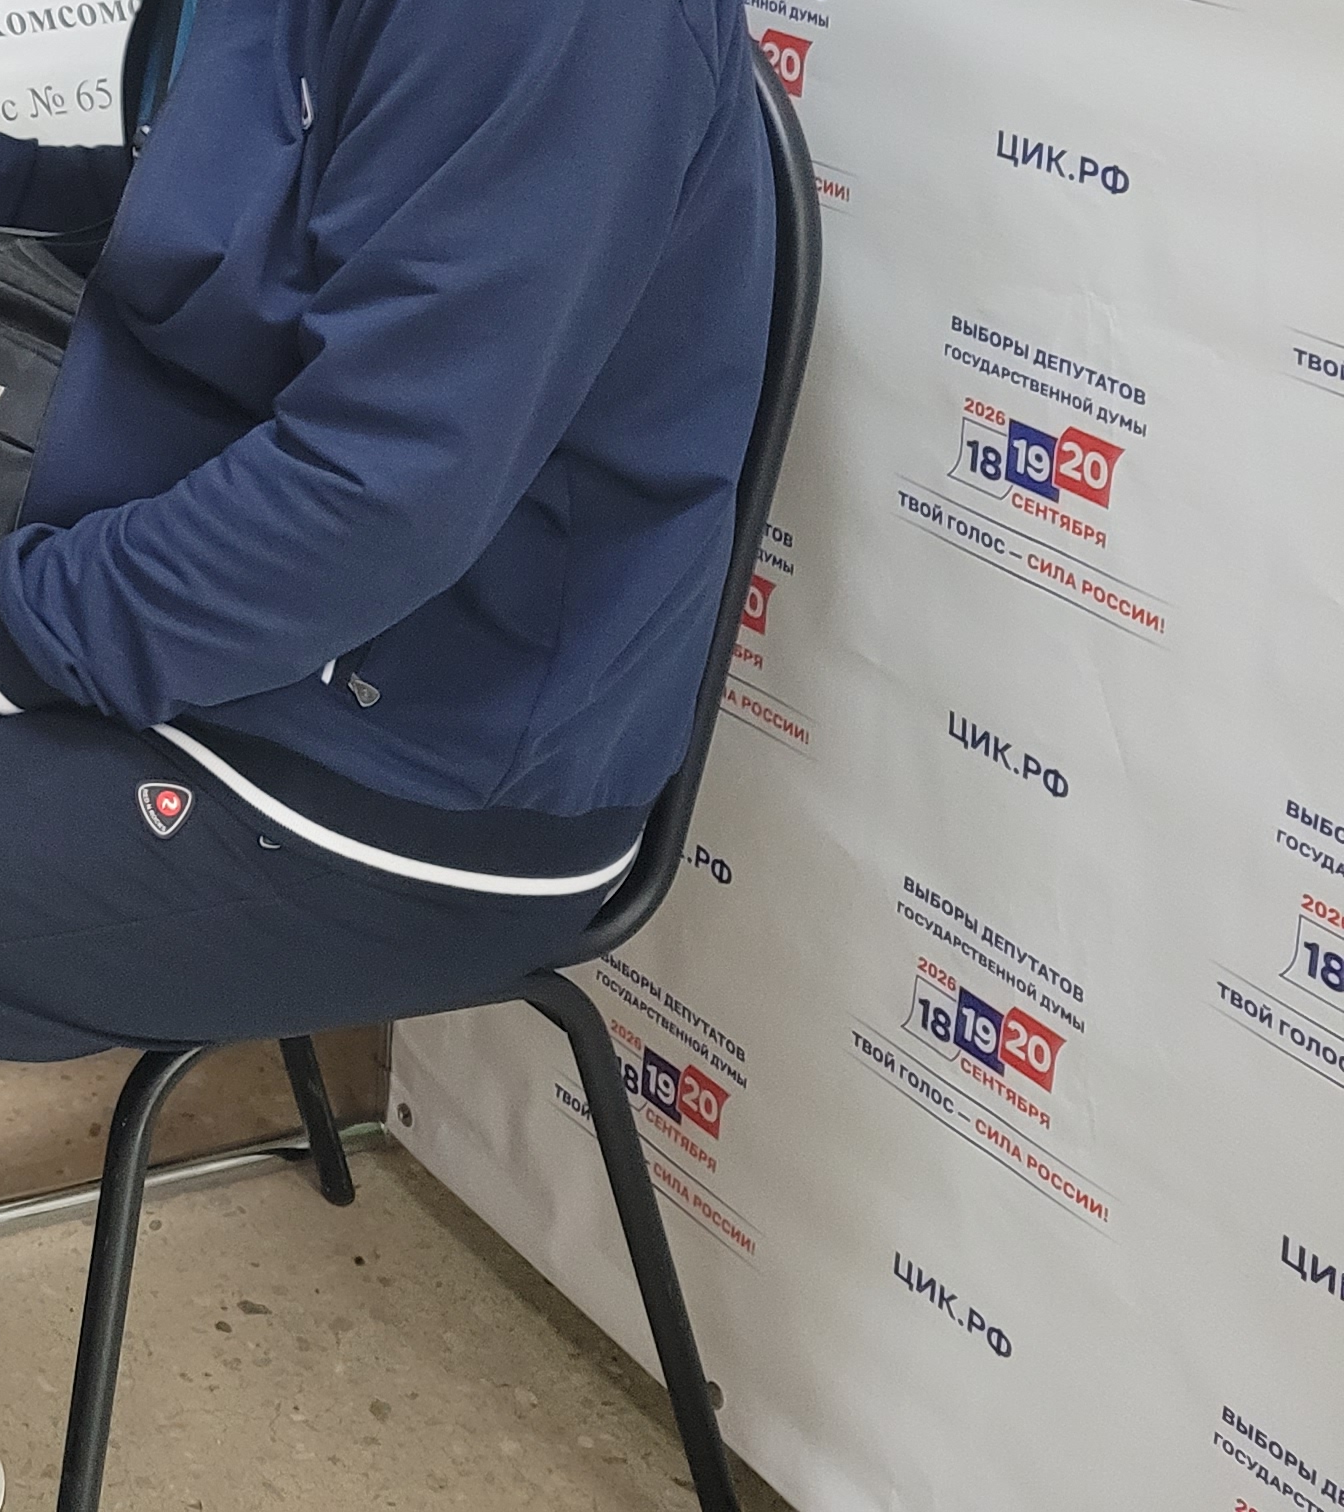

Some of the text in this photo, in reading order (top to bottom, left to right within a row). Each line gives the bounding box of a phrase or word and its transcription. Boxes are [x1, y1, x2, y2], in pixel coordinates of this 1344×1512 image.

[789, 5, 829, 29] ДУМЫ
[2, 78, 113, 121] с № 65
[997, 130, 1130, 195] ЦИК.РФ
[950, 315, 1147, 406] ВЫБОРЫ ДЕПУТАТОВ
[1293, 347, 1344, 380] ТВО
[944, 343, 1147, 438] ГОСУДАРСТВЕННОЙ ДУМЫ
[964, 397, 1006, 427] 2026
[966, 439, 1002, 481] 18
[1012, 439, 1050, 482] 19
[1059, 441, 1109, 489] 20
[1011, 491, 1107, 549] СЕНТЯБРЯ
[898, 490, 943, 526] ТВОЙ
[947, 513, 1006, 555] ГОЛОС
[1027, 553, 1077, 590] СИЛА
[1082, 580, 1165, 634] РОССИИ!
[741, 696, 810, 745] РОССИИ!
[949, 710, 1069, 798] ЦИК.РФ
[683, 844, 732, 885] .РФ
[1301, 893, 1344, 930] 202
[903, 875, 1085, 1004] ВЫБОРЫ ДЕПУТАТОВ
[896, 900, 1085, 1034] ГОСУДАРСТВЕННОЙ ДУМЫ
[917, 956, 957, 992] 2026
[1303, 941, 1344, 993] 18
[596, 969, 748, 1089] ГОСУДАРСТВЕННОЙ ДУМЫ
[663, 992, 746, 1063] ДЕПУТАТОВ
[918, 997, 952, 1043] 18
[961, 1007, 997, 1054] 19
[1217, 981, 1272, 1029] ТВОЙ
[1005, 1021, 1052, 1073] 20
[646, 1063, 677, 1106] 19
[683, 1076, 719, 1124] 20
[961, 1057, 1051, 1130] СЕНТЯБРЯ
[645, 1108, 718, 1175] СЕНТЯБРЯ
[852, 1030, 896, 1074] ТВОЙ
[899, 1065, 955, 1115] ГОЛОС
[975, 1118, 1022, 1162] СИЛА
[1027, 1153, 1109, 1223] РОССИИ!
[653, 1162, 756, 1256] СИЛА РОССИИ!
[894, 1250, 1012, 1358] ЦИК.РФ
[1222, 1405, 1317, 1486] ВЫБОРЫ
